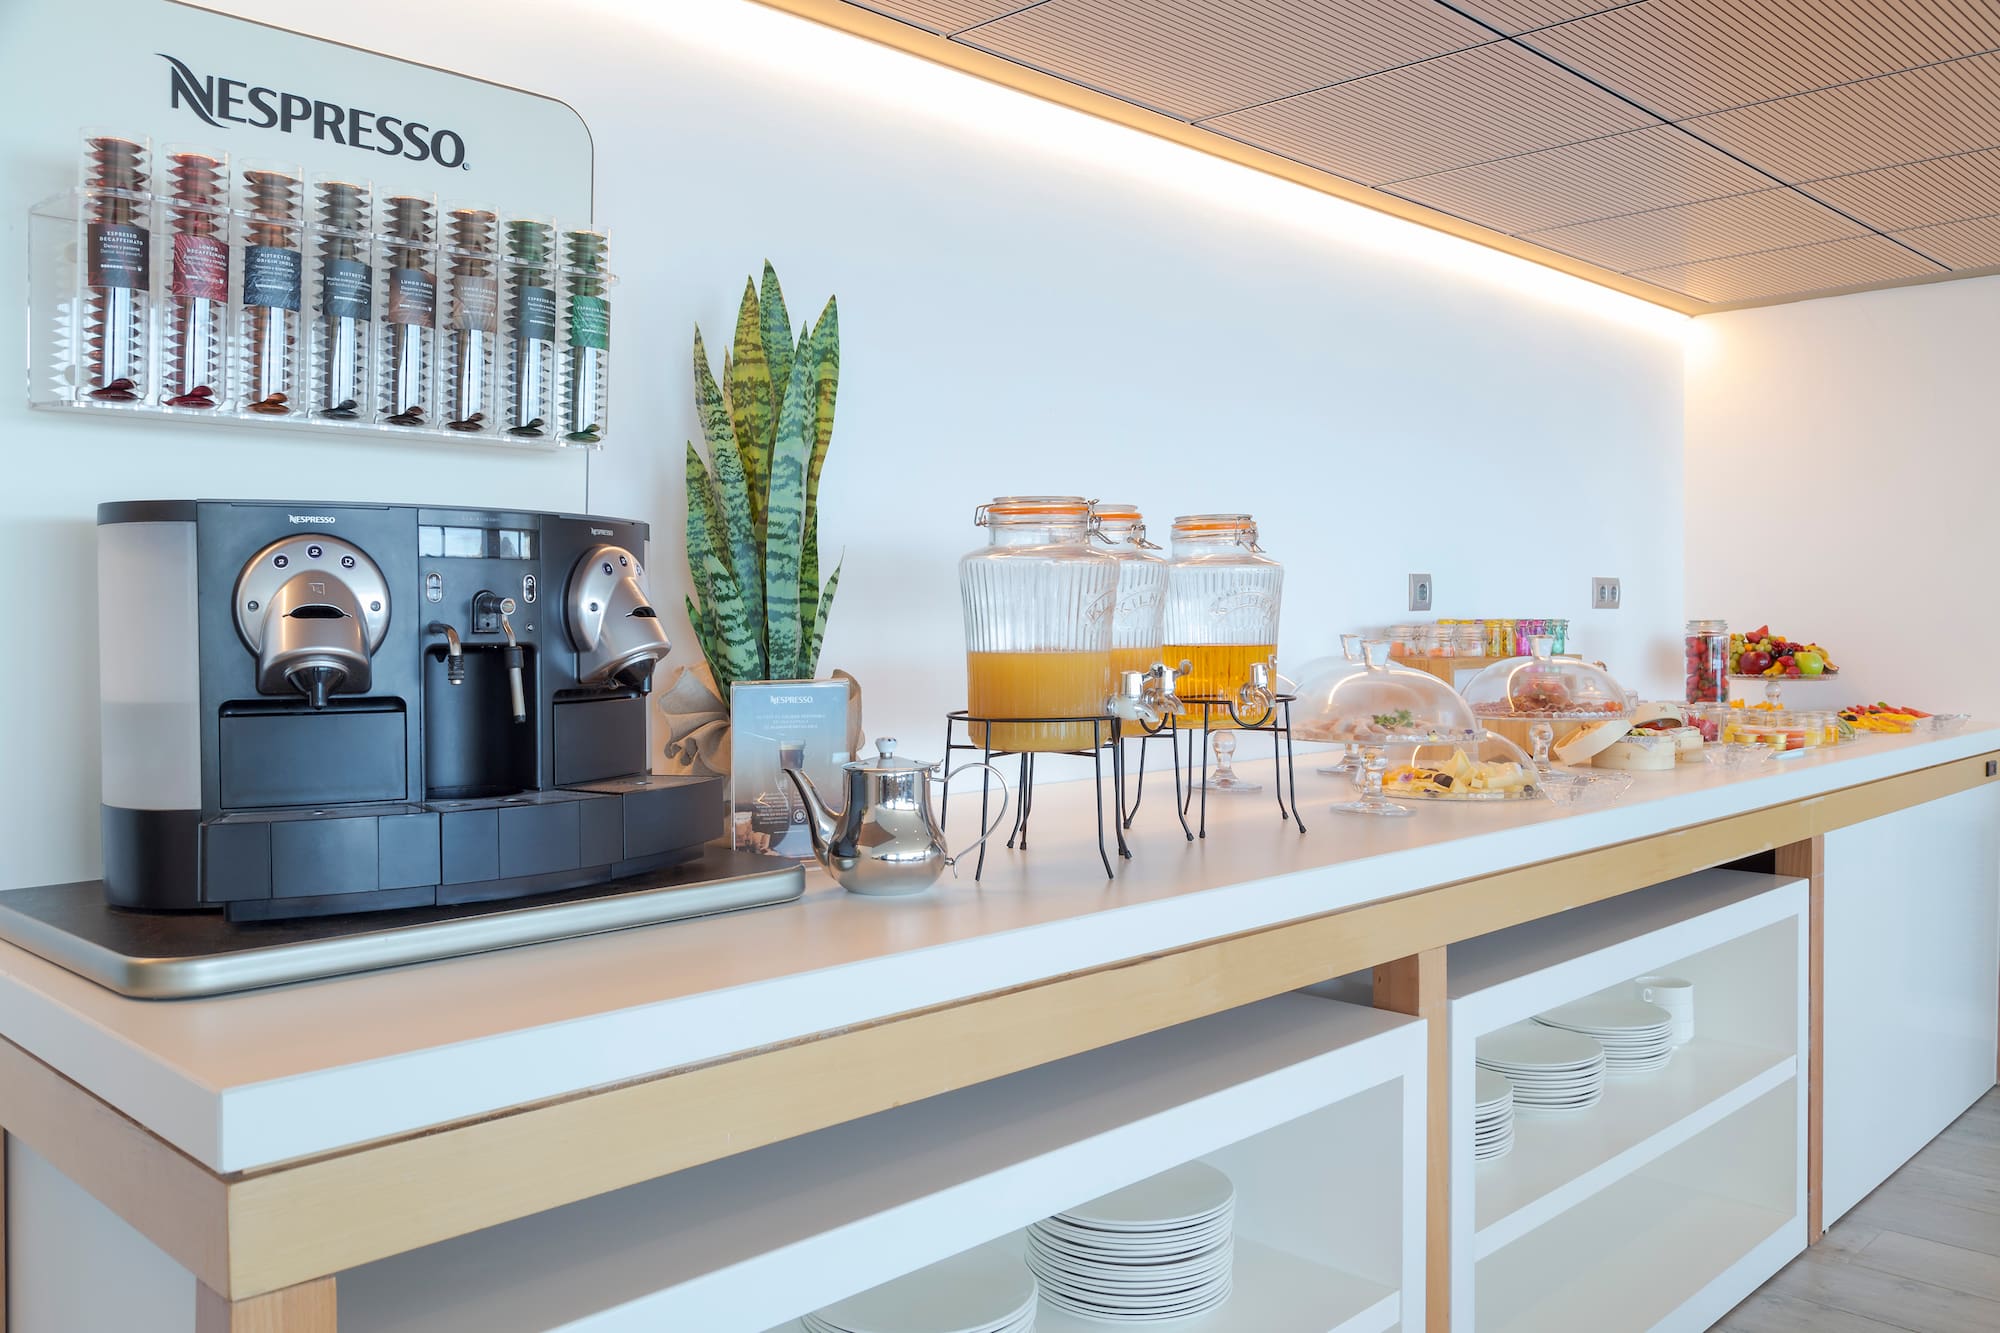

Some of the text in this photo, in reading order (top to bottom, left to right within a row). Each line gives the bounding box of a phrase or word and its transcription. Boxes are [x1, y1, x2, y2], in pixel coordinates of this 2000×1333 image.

[154, 53, 466, 168] NESPRESSO
[106, 231, 137, 239] ESPRESSO
[288, 514, 336, 524] NESPRESSO
[769, 695, 814, 705] NESPRESSO
